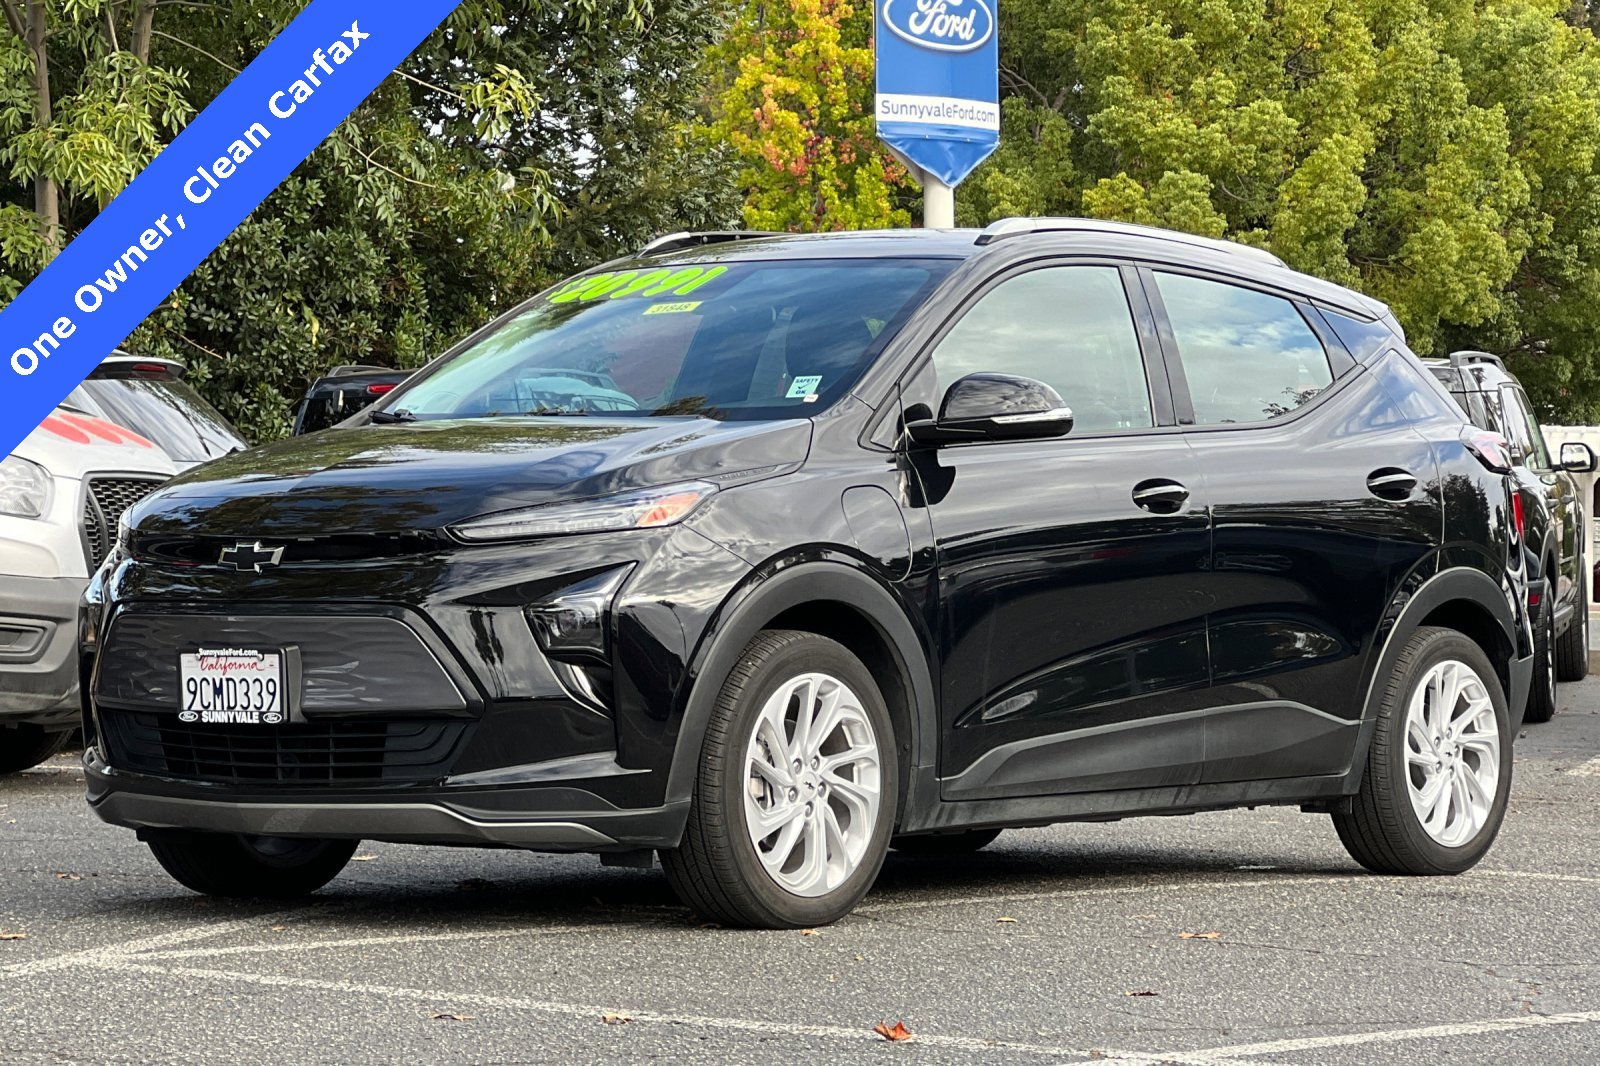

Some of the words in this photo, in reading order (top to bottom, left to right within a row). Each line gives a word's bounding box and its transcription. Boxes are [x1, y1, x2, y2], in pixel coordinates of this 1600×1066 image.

[908, 0, 977, 41] Ford
[880, 99, 997, 123] SunnyvaleFord.com
[198, 648, 258, 657] SunnyvaleFord.com
[200, 656, 265, 676] California
[186, 677, 276, 711] 9CMD339
[202, 711, 259, 723] SUNNYVALE
